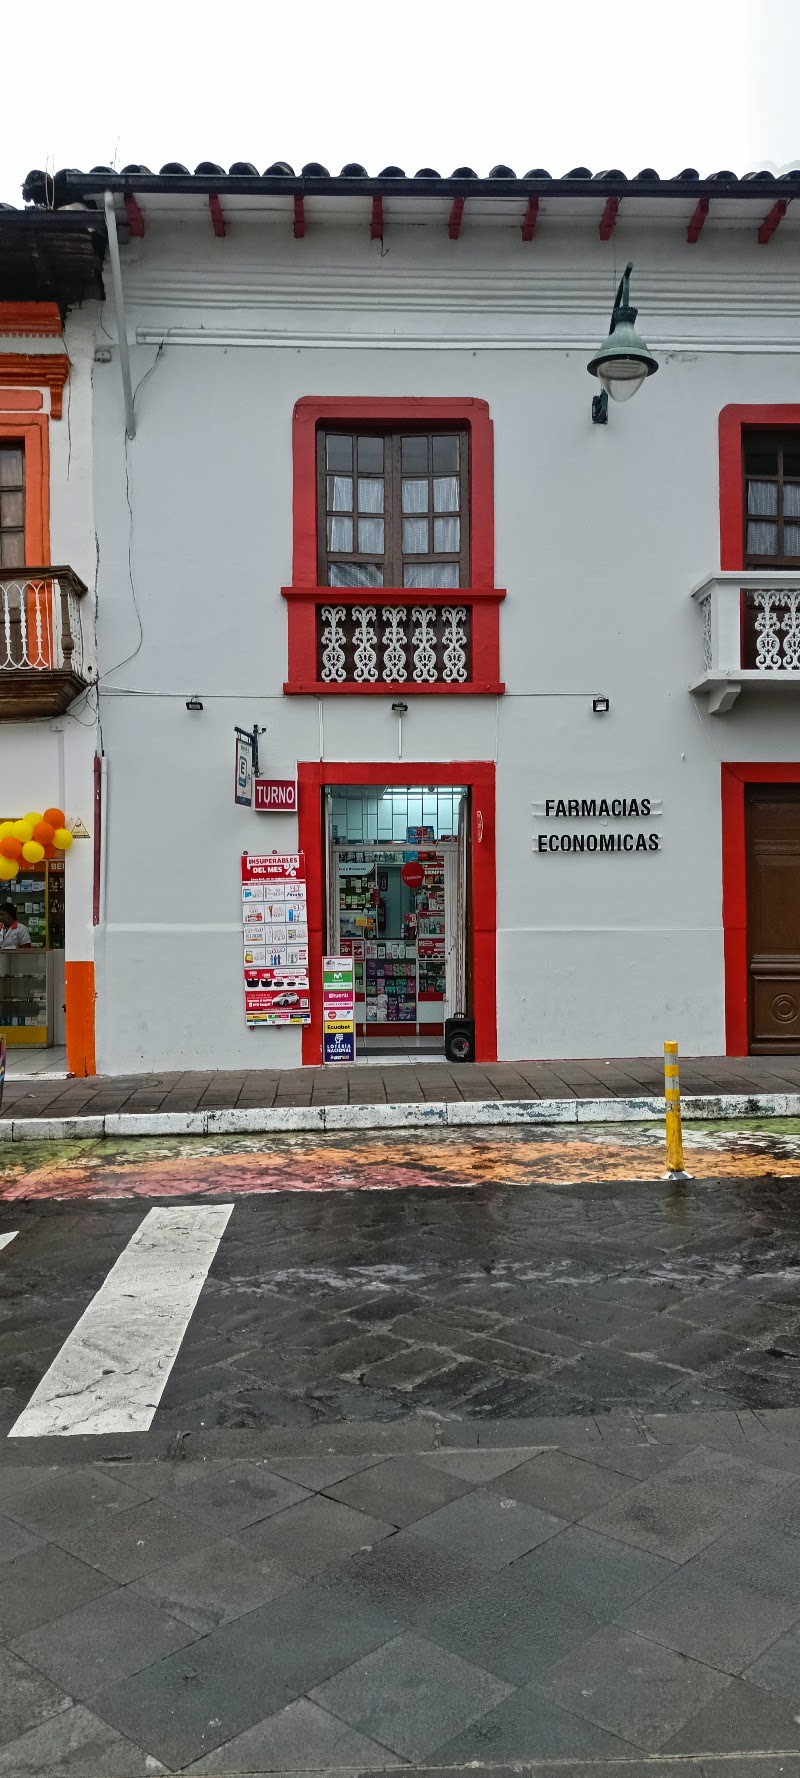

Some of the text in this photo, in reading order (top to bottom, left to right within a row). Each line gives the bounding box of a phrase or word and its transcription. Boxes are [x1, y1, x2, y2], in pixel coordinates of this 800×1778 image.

[256, 785, 295, 804] TURNO
[545, 799, 651, 817] FARMACIAS
[538, 834, 659, 852] ECONOMICAS
[248, 857, 298, 865] INSUPERABLES
